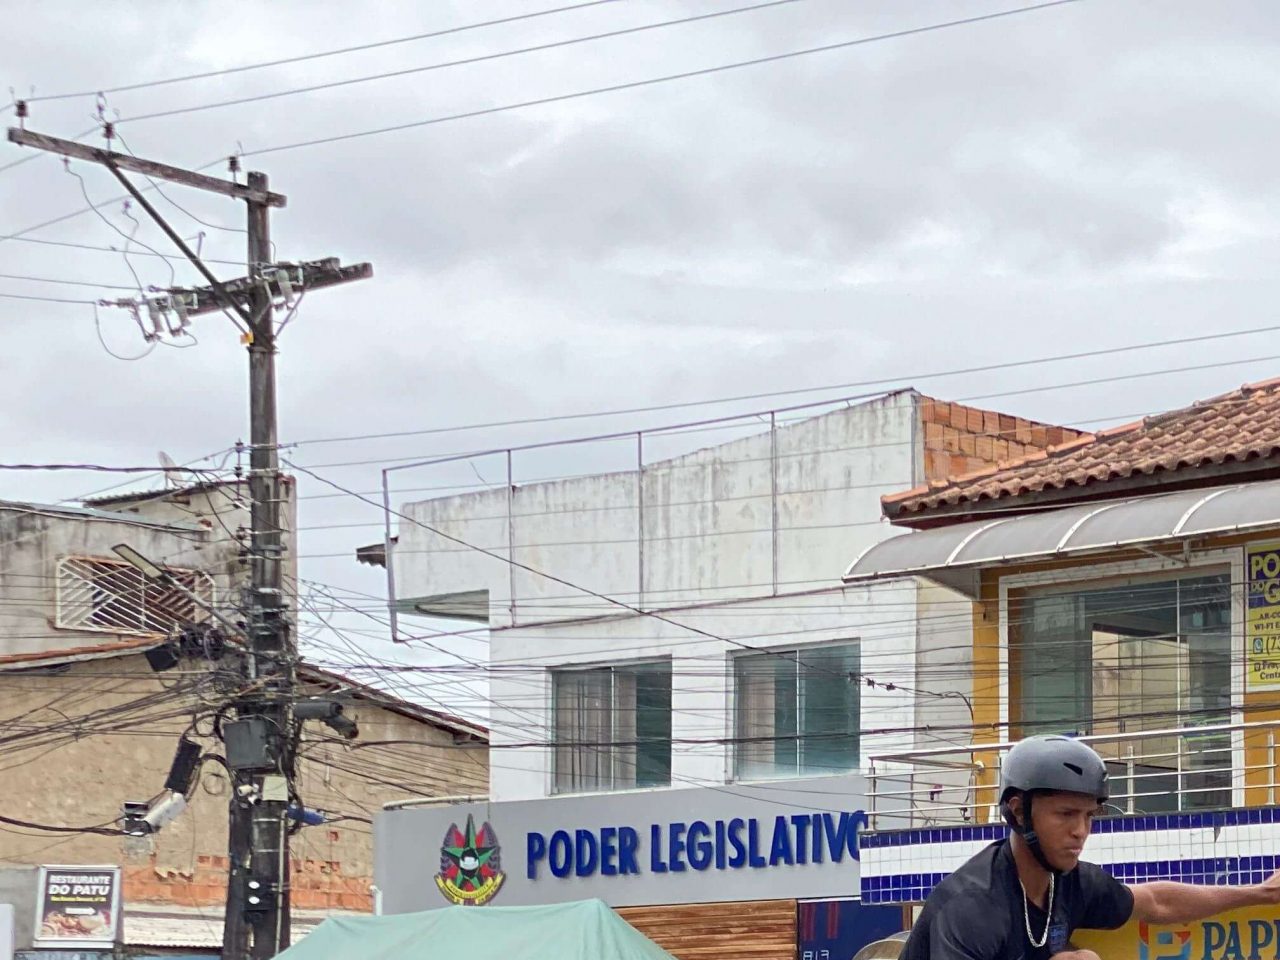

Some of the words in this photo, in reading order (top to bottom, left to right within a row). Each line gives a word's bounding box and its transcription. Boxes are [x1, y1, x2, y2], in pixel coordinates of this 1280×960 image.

[527, 826, 641, 880] PODER
[50, 875, 111, 884] RESTAURANTE
[48, 885, 70, 895] DO
[72, 885, 110, 895] PATU
